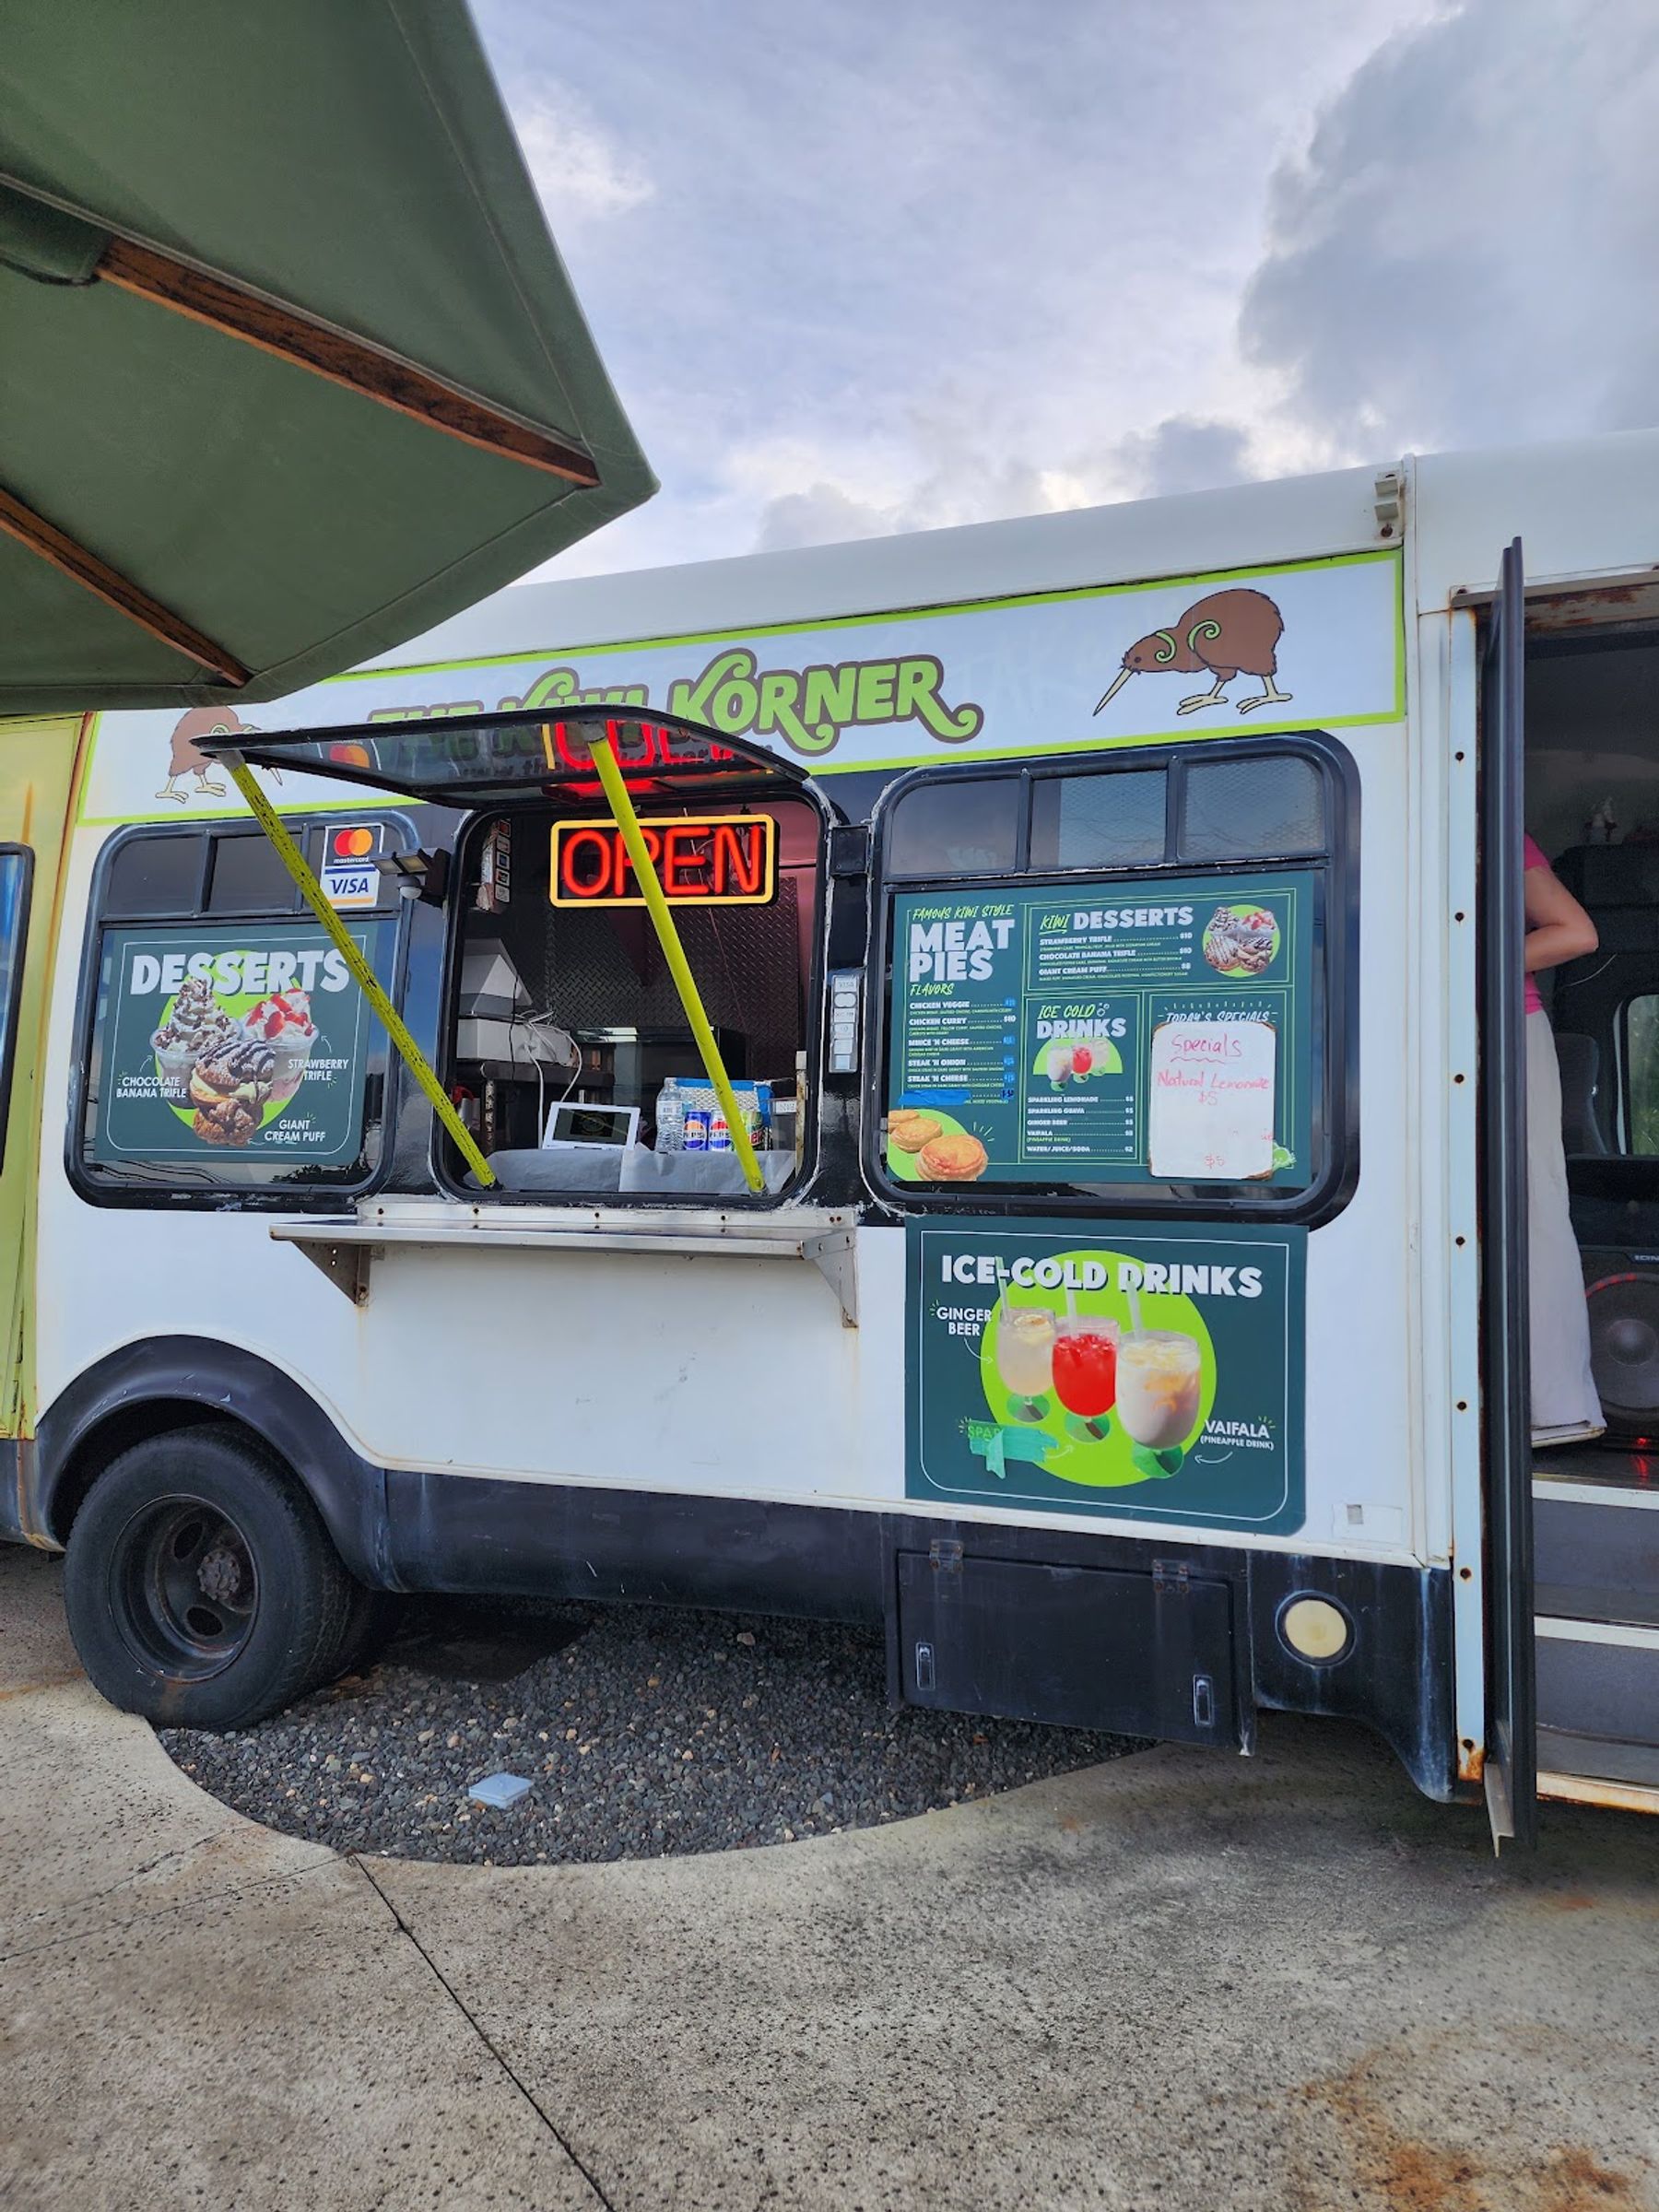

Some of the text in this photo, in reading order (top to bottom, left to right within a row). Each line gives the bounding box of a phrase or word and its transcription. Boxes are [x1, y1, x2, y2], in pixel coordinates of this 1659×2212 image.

[668, 648, 984, 757] KORNER
[333, 856, 370, 865] mastercard
[562, 824, 761, 897] OPEN
[329, 877, 370, 894] VISA
[912, 904, 1015, 922] FAMOUS KIWI STYLE
[1039, 906, 1194, 931] KIWI DESSERTS
[910, 919, 1016, 952] MEAT
[1039, 932, 1193, 947] STRAWBERRY TRIFLE $10
[1039, 951, 1081, 961] CHOCOLATE
[1081, 950, 1112, 959] BANANA
[1112, 949, 1136, 958] TRIFLE
[130, 948, 351, 996] DESSERTS
[909, 949, 994, 982] PIES
[1038, 968, 1062, 976] GIANT
[1062, 967, 1088, 975] CREAM
[1088, 966, 1107, 974] PUFF
[910, 982, 955, 996] FLAVORS
[910, 1001, 971, 1010] CHICKEN VEGGIE
[1038, 1004, 1096, 1019] ICE COLD
[909, 1015, 1017, 1026] CHICKEN CURRY $10
[1166, 1010, 1270, 1022] TODAY'S SPECIALS
[1037, 1017, 1127, 1040] DRINKS
[908, 1039, 932, 1047] MINCE
[941, 1038, 971, 1046] CHEESE
[1171, 1032, 1242, 1057] Specials
[288, 1058, 349, 1070] STRAWBERRY
[908, 1059, 931, 1067] STEAK
[940, 1058, 966, 1066] ONION
[122, 1077, 181, 1088] CHOCOLATE
[303, 1070, 333, 1081] TRIFLE
[907, 1075, 931, 1083] STEAK
[939, 1074, 969, 1082] CHEESE
[1157, 1069, 1205, 1088] Natural
[116, 1088, 187, 1099] BANANA TRIFLE
[1198, 1090, 1218, 1106] $5
[279, 1119, 311, 1131] GIANT
[265, 1131, 326, 1142] CREAM PUFF
[941, 1254, 1264, 1299] ICE-COLD DRINKS
[936, 1306, 993, 1323] GINGER
[947, 1322, 981, 1336] BEER
[1205, 1419, 1270, 1439] VAIFALA
[1200, 1434, 1275, 1452] (PINEAPPLE DRINK)
